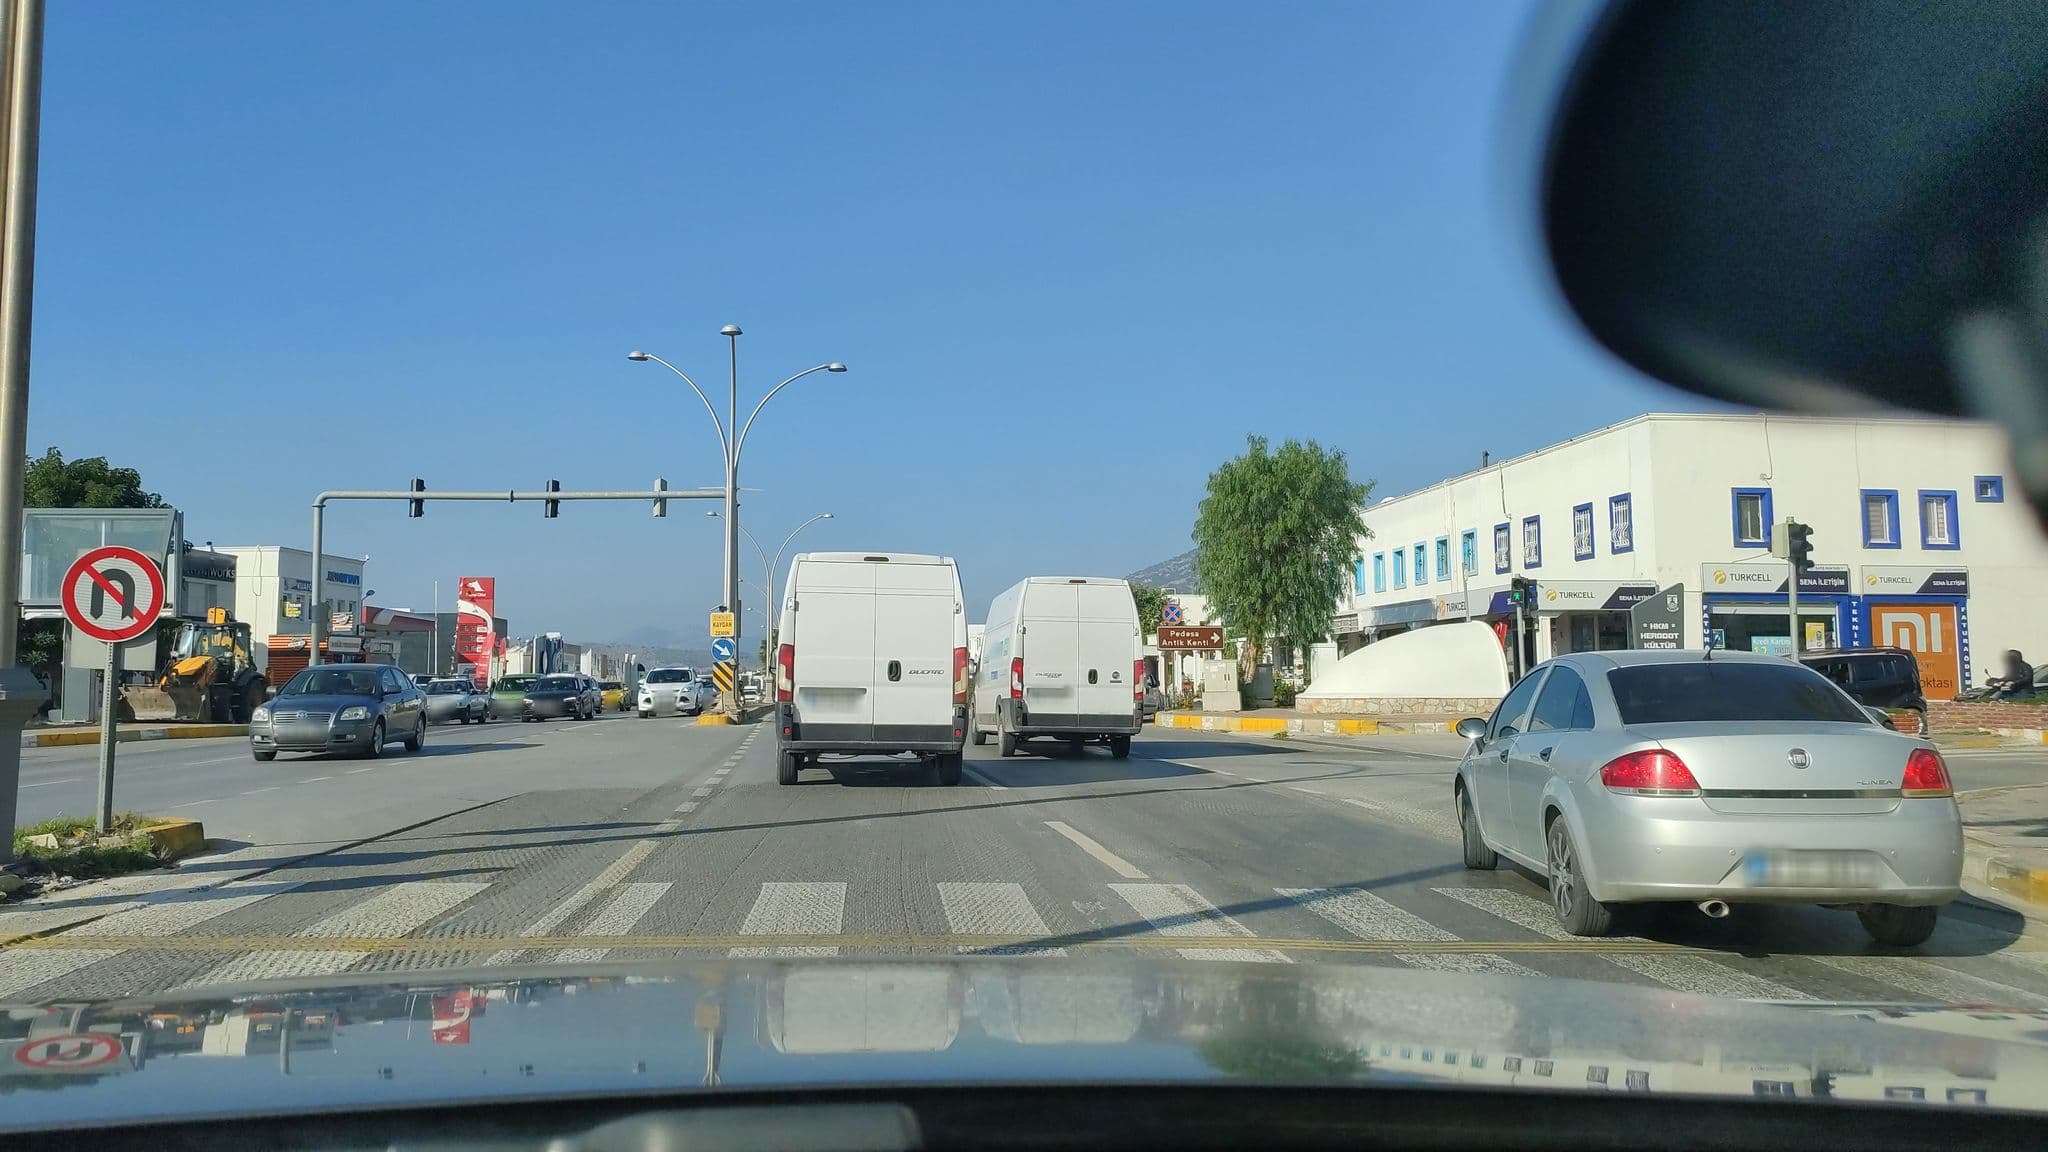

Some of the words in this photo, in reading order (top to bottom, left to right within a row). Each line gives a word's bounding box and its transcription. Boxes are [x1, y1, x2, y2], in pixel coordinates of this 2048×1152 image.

[1729, 573, 1771, 581] TURKCELL
[1879, 576, 1912, 584] TURKCELL
[1799, 578, 1817, 586] SENA
[1818, 576, 1845, 587] İLETİŞİM
[1559, 591, 1595, 599] TURKCELL
[1649, 622, 1669, 630] HKM
[1960, 606, 1969, 652] FATURA
[1640, 632, 1680, 640] HERODOT
[1643, 640, 1677, 649] KÜLTÜR
[1920, 677, 1953, 688] oktası
